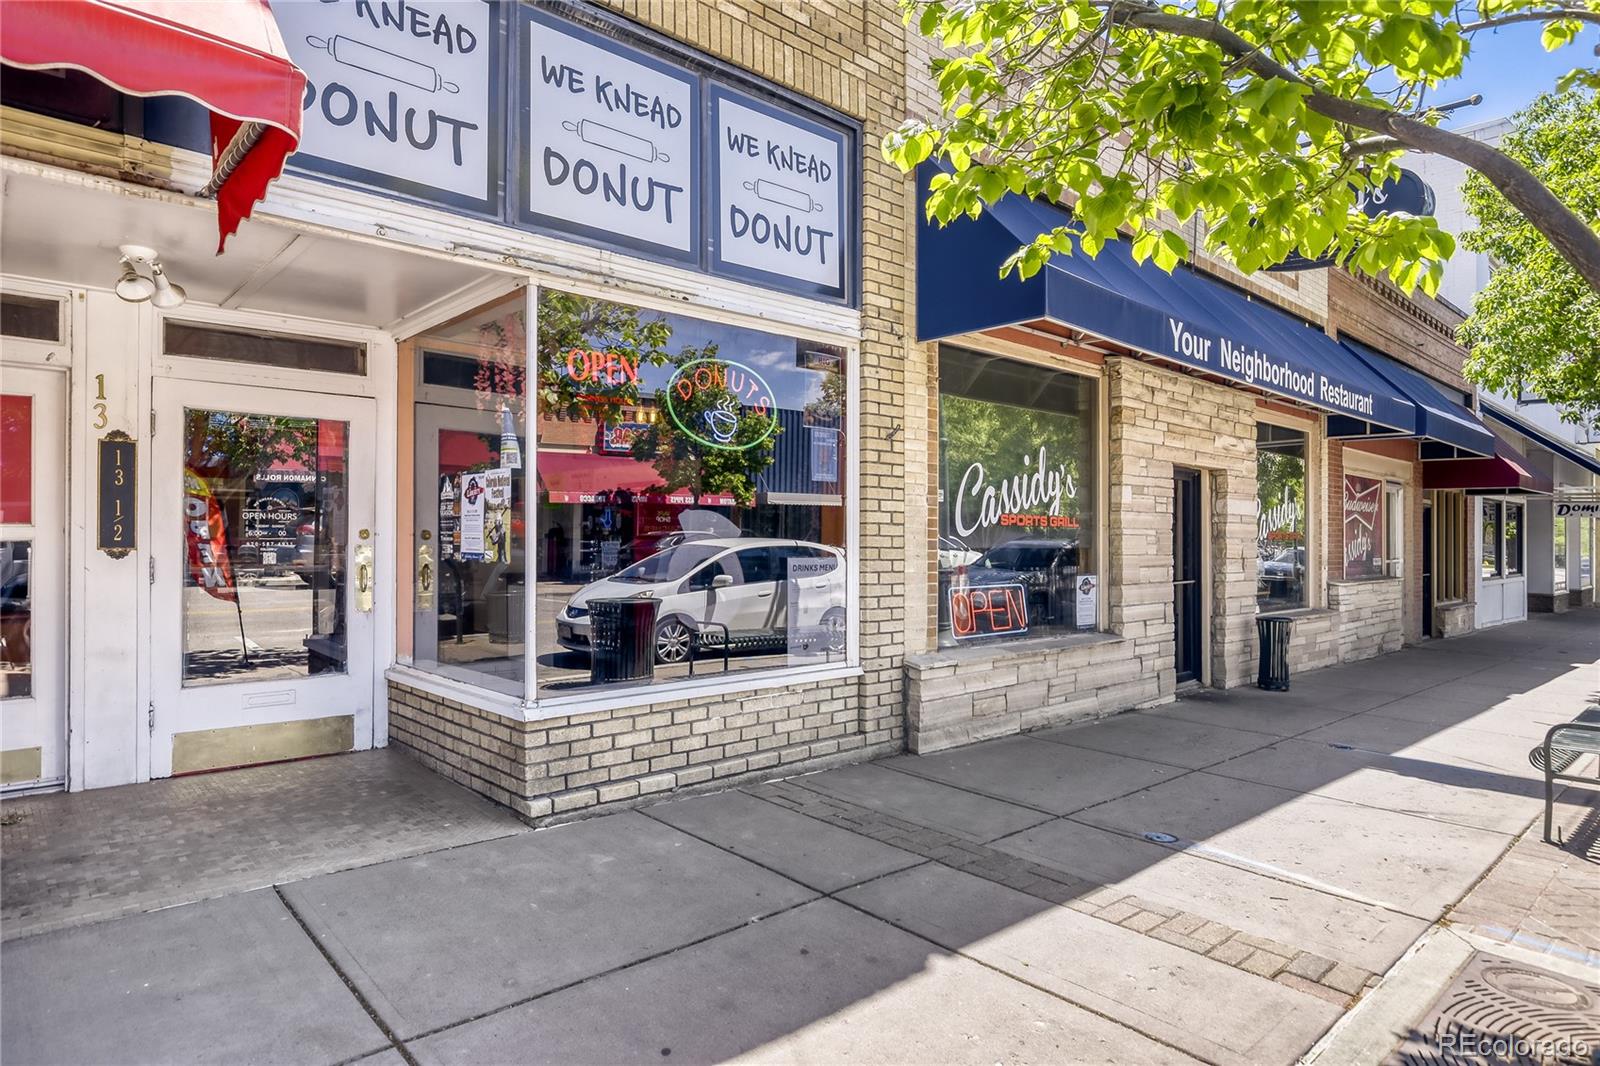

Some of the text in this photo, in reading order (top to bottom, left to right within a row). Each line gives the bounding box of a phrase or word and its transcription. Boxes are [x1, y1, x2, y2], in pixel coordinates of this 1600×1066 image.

[541, 55, 682, 129] WE KNEAD
[727, 126, 831, 183] WE KNEAD
[543, 146, 683, 224] DONUT
[730, 204, 833, 265] DONUT
[567, 348, 638, 385] OPEN
[677, 364, 770, 416] DONUTS
[1169, 318, 1373, 416] Your Neighborhood Restaurant
[242, 512, 297, 520] OPEN HOURS
[955, 446, 1077, 537] Cassidy's
[1000, 513, 1080, 528] SPORTS GRILL
[792, 564, 818, 572] DRINKS
[952, 589, 1026, 634] OPEN
